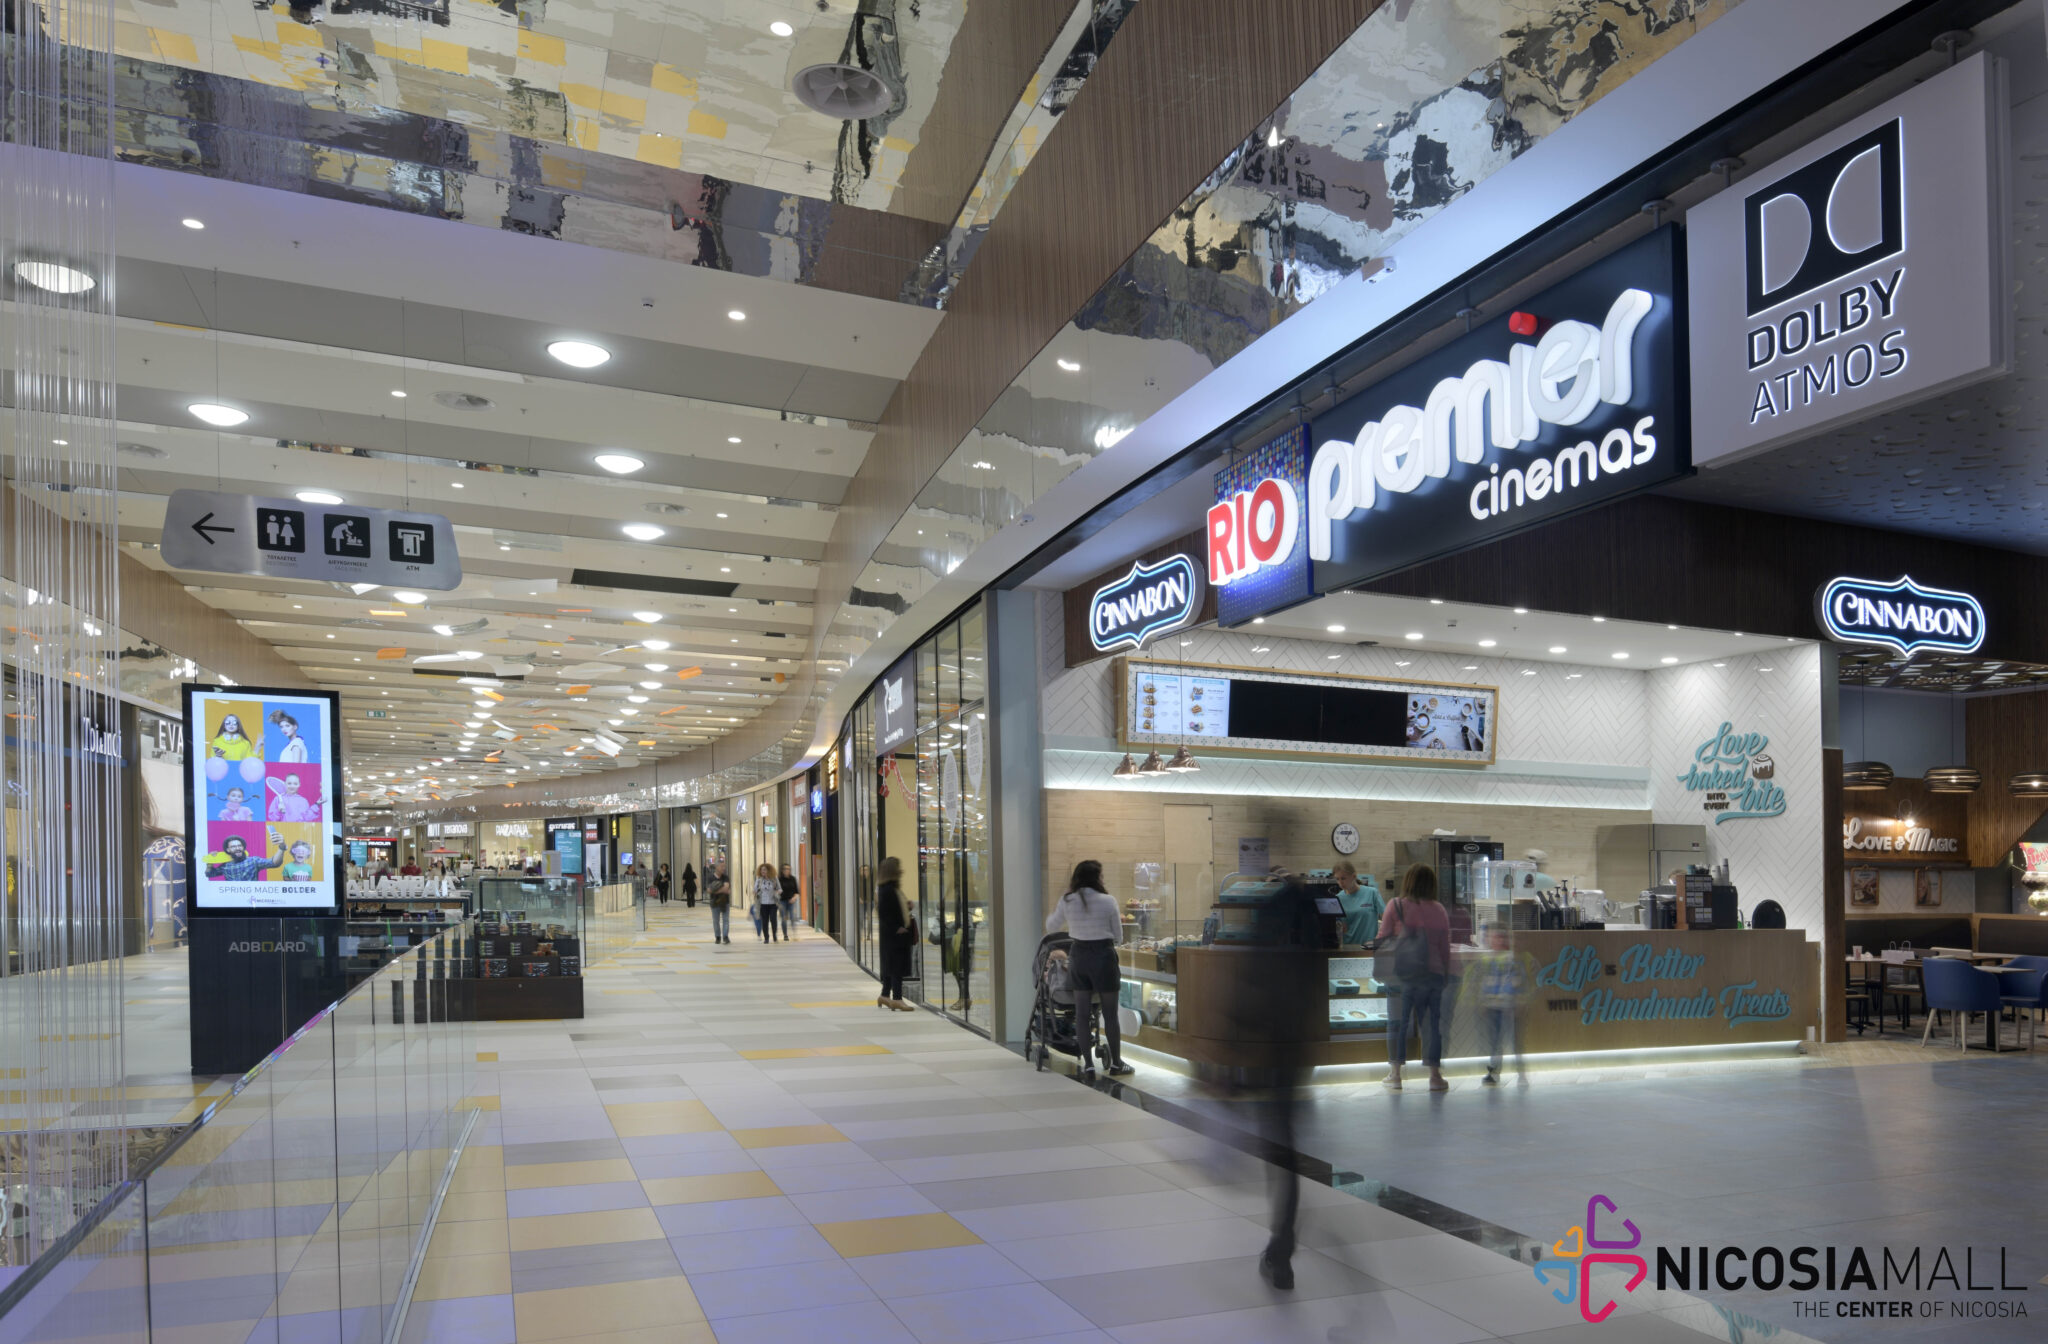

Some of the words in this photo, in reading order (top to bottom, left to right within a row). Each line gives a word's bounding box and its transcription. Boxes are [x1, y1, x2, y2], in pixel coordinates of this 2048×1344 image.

[1747, 267, 1906, 370] DOLBY
[1749, 329, 1908, 424] ATMOS
[1207, 477, 1297, 585] RIO
[1309, 288, 1654, 562] premier
[1470, 416, 1656, 521] cinemas
[1096, 572, 1186, 636] CINNABON
[1834, 592, 1974, 638] CINNABON
[1696, 721, 1769, 765] Love
[1677, 761, 1748, 791] baked
[1715, 778, 1788, 825] bite
[219, 886, 252, 894] SPRING
[254, 886, 279, 894] MADE
[282, 886, 316, 894] BOLDER
[228, 941, 306, 953] ADBOARD
[1536, 944, 1603, 992] Life
[1620, 943, 1706, 984] Better
[1547, 998, 1578, 1012] WITH
[1581, 987, 1716, 1026] Handmade
[1719, 980, 1793, 1029] Treats
